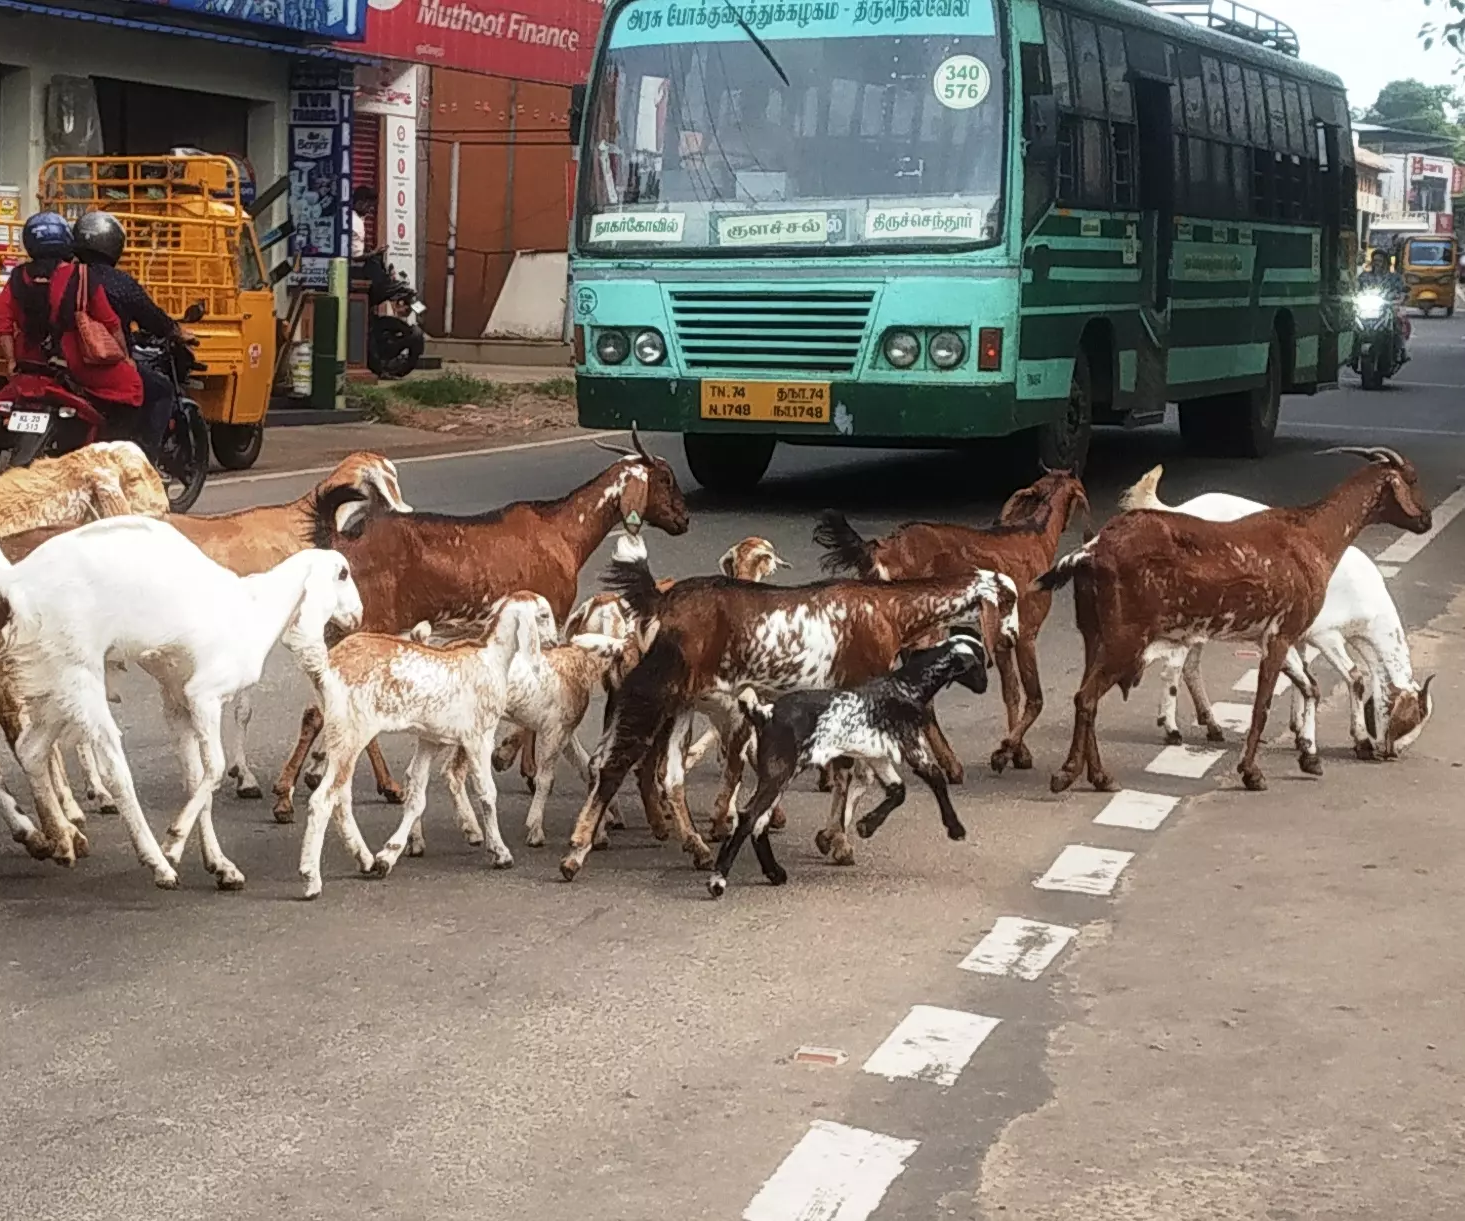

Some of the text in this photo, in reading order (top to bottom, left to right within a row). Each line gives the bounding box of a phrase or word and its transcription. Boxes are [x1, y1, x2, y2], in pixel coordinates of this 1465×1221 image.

[417, 1, 580, 51] Muthoot Finance
[627, 9, 663, 32] அரசு
[945, 65, 980, 81] 340
[944, 84, 979, 99] 576
[297, 138, 329, 153] Berger
[595, 217, 679, 236] நாகர்கோவில்
[872, 212, 974, 232] திருச்செந்தூர்
